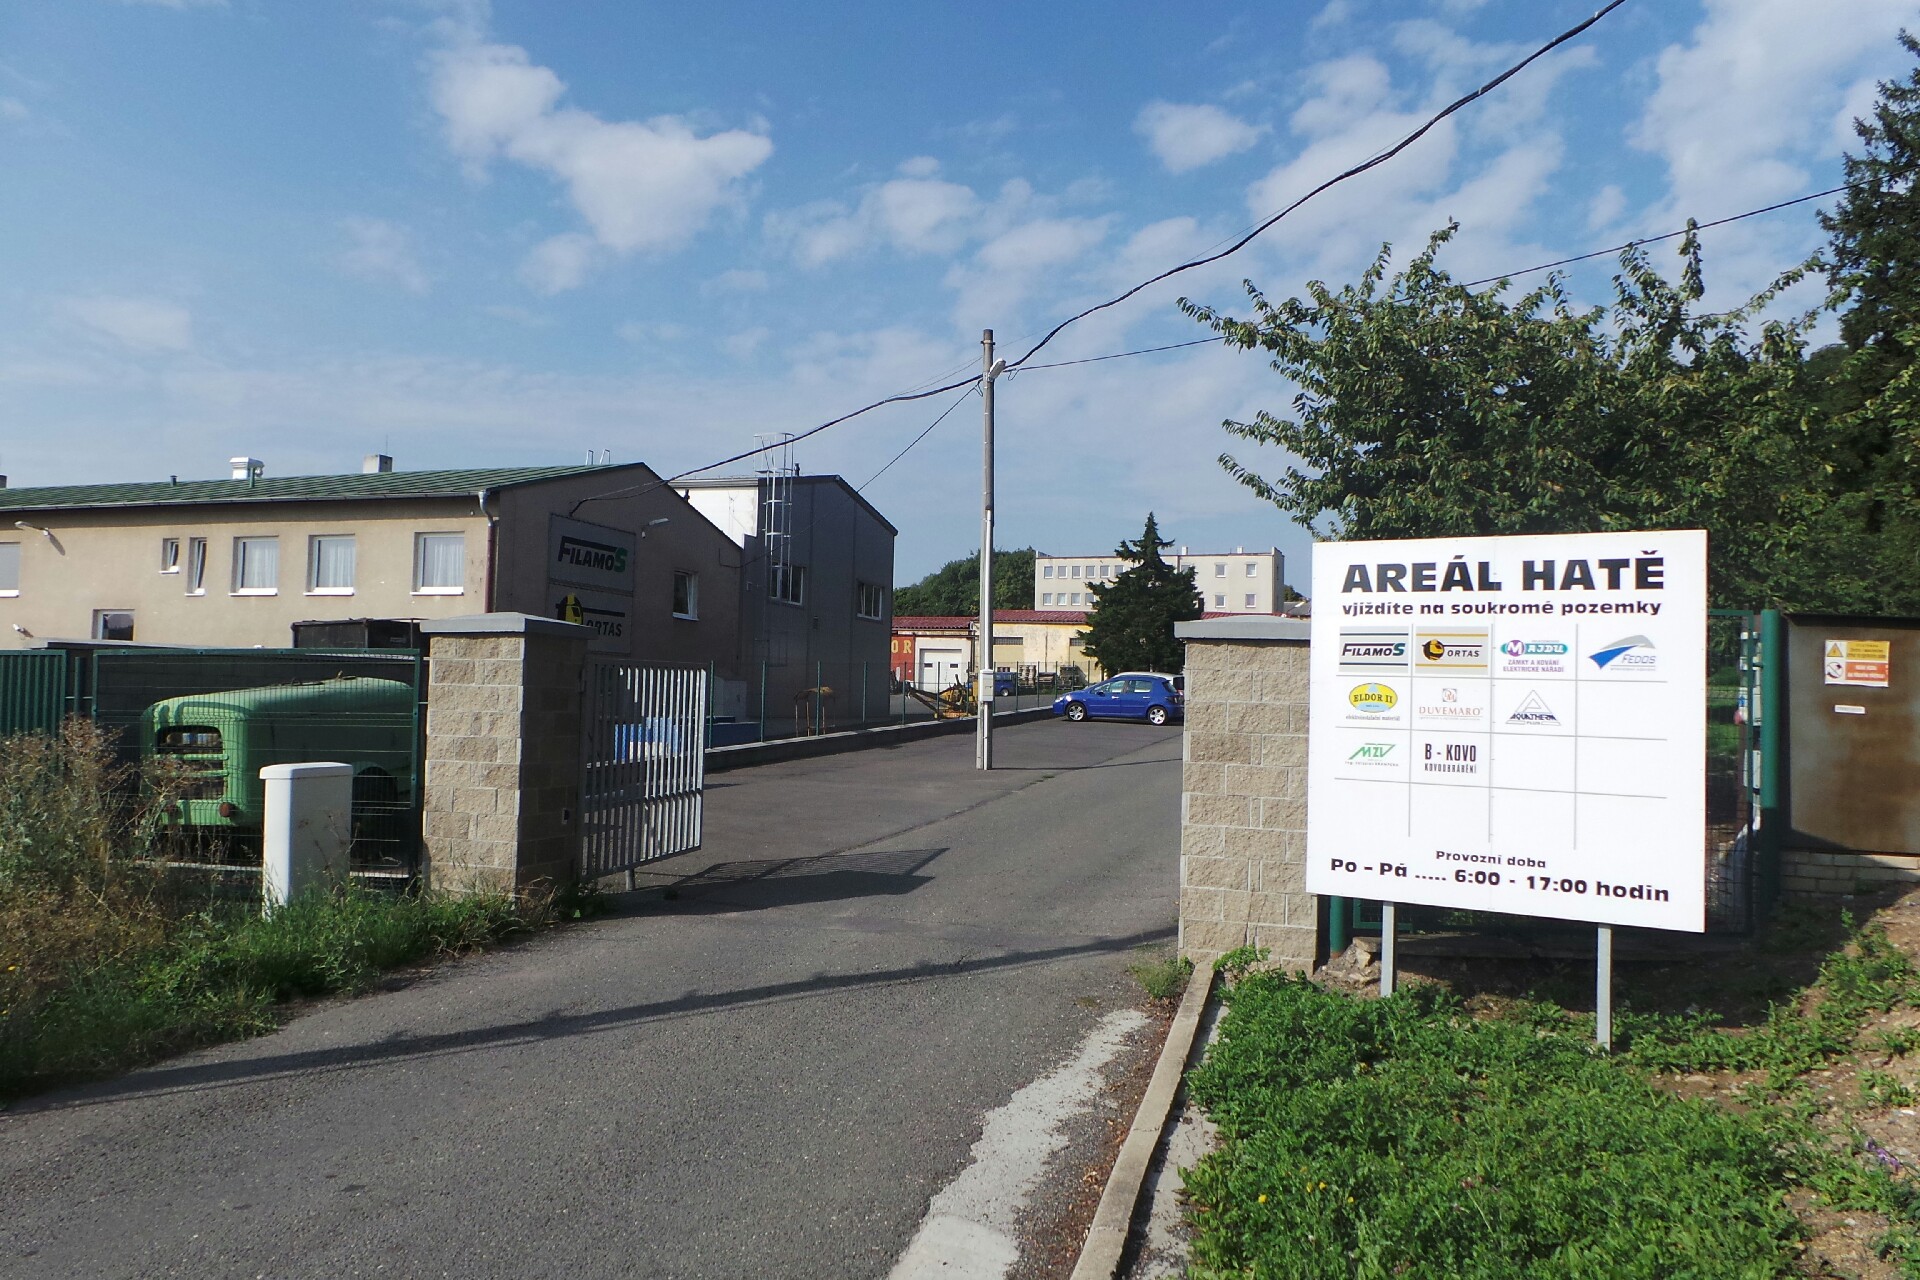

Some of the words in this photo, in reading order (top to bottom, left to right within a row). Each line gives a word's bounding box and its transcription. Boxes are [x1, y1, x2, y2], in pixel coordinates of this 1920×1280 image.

[1342, 555, 1502, 593] AREÁL
[1522, 550, 1664, 591] HATĚ
[1342, 601, 1414, 617] vjíždíte
[1420, 603, 1445, 615] na
[1451, 600, 1554, 615] soukromé
[1561, 601, 1662, 617] pozemky
[1446, 649, 1481, 658] ORTAS
[1353, 693, 1383, 703] ELDOR
[1385, 694, 1394, 704] II
[1419, 706, 1481, 716] DUVEMARO
[1425, 743, 1432, 760] B
[1446, 744, 1477, 762] KOVO
[1424, 762, 1477, 774] KOVOOBRÁBĚNÍ
[1435, 850, 1502, 865] Provozní
[1506, 856, 1547, 869] doba
[1330, 858, 1357, 873] Po
[1379, 862, 1408, 878] Pá
[1454, 869, 1501, 886] 6:00
[1526, 875, 1588, 895] 17:00
[1595, 880, 1670, 903] hodin
